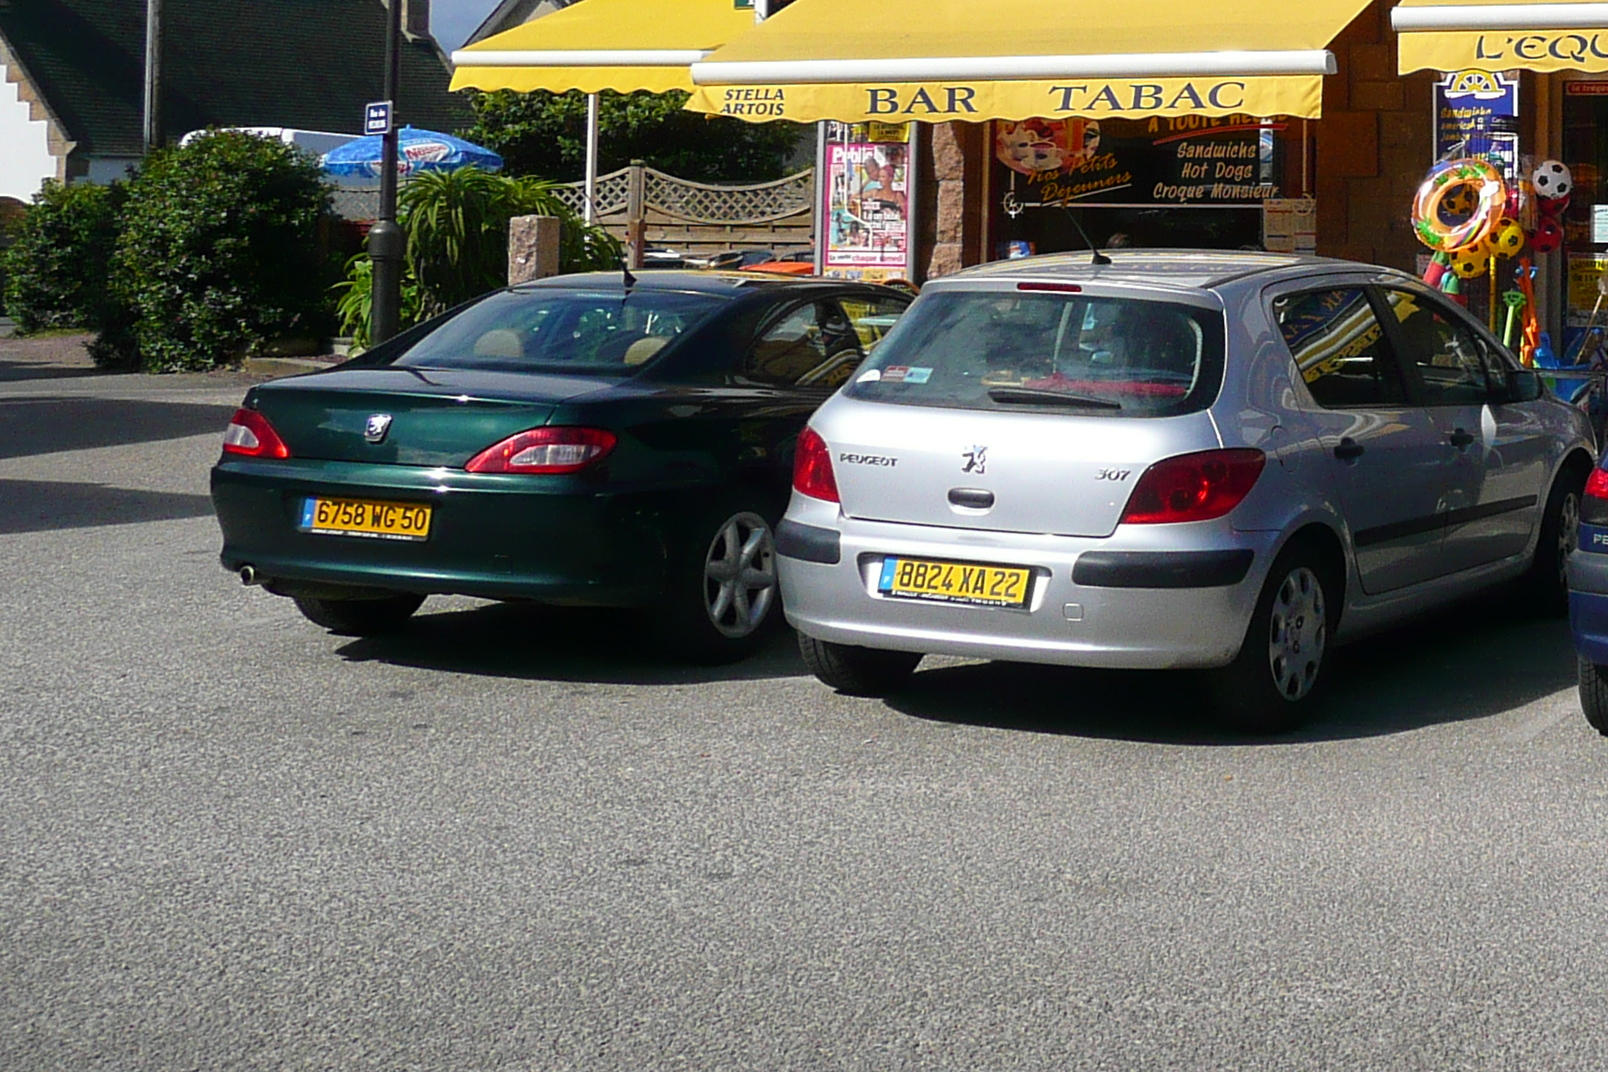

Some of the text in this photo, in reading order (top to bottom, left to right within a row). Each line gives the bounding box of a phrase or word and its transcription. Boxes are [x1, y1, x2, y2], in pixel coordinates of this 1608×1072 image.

[724, 89, 784, 101] STELLA
[865, 82, 1247, 115] BAR TABAC
[720, 103, 784, 116] ARTOIS
[1148, 117, 1158, 132] A
[1177, 142, 1257, 159] Sandwichs
[1069, 152, 1119, 176] Petits
[1181, 162, 1253, 180] Hot Dogs
[1153, 182, 1281, 202] Croque Monsieur
[852, 254, 877, 262] chaque
[840, 452, 898, 468] PEUGEOT
[1095, 468, 1131, 482] 307
[317, 501, 366, 526] 6758
[371, 505, 396, 529] WG
[401, 507, 427, 531] 50
[899, 562, 953, 590] 8824
[960, 568, 987, 594] XA
[989, 571, 1021, 598] 22
